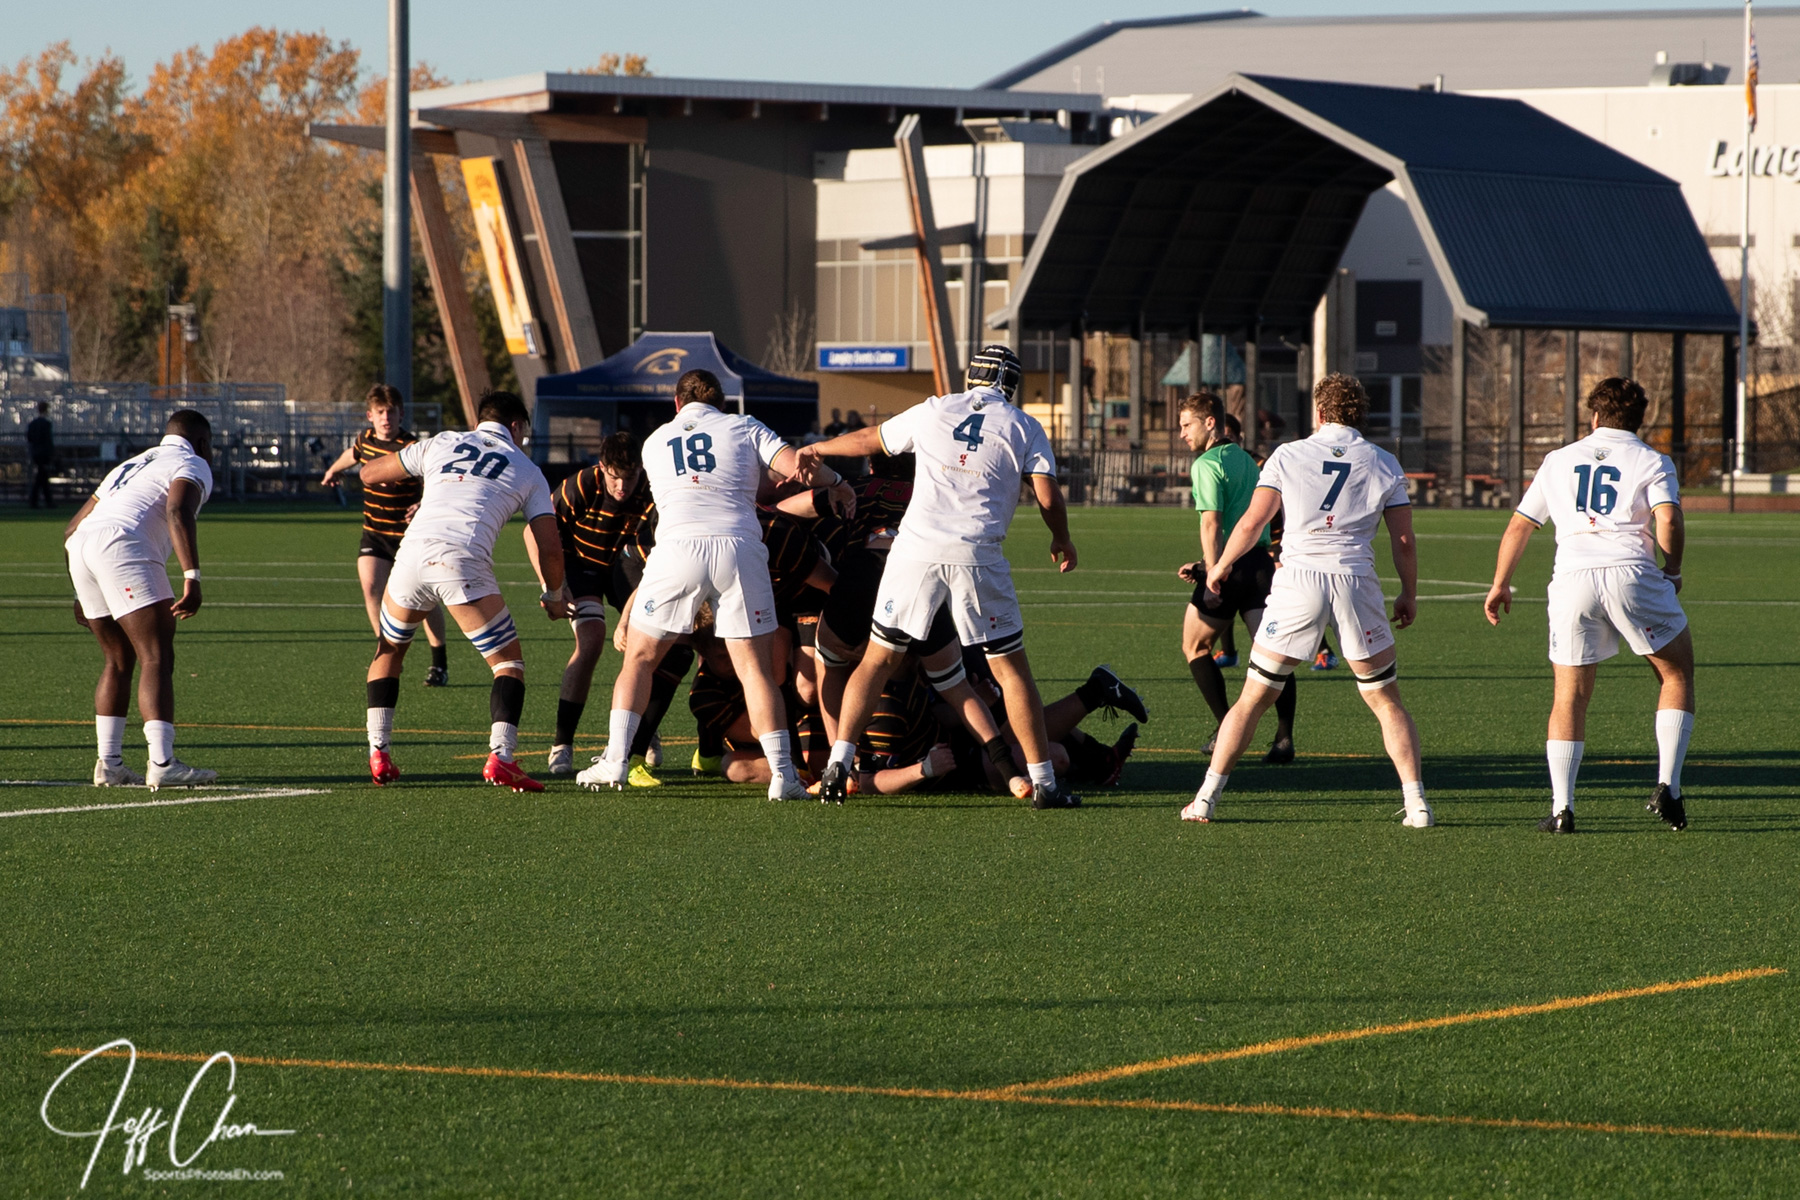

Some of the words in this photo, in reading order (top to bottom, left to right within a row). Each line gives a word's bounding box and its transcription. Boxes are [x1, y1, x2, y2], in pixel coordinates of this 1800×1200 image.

[667, 432, 717, 476] 18
[953, 413, 986, 452] 4
[440, 442, 510, 480] 20
[1319, 461, 1352, 512] 7
[1574, 464, 1621, 515] 16
